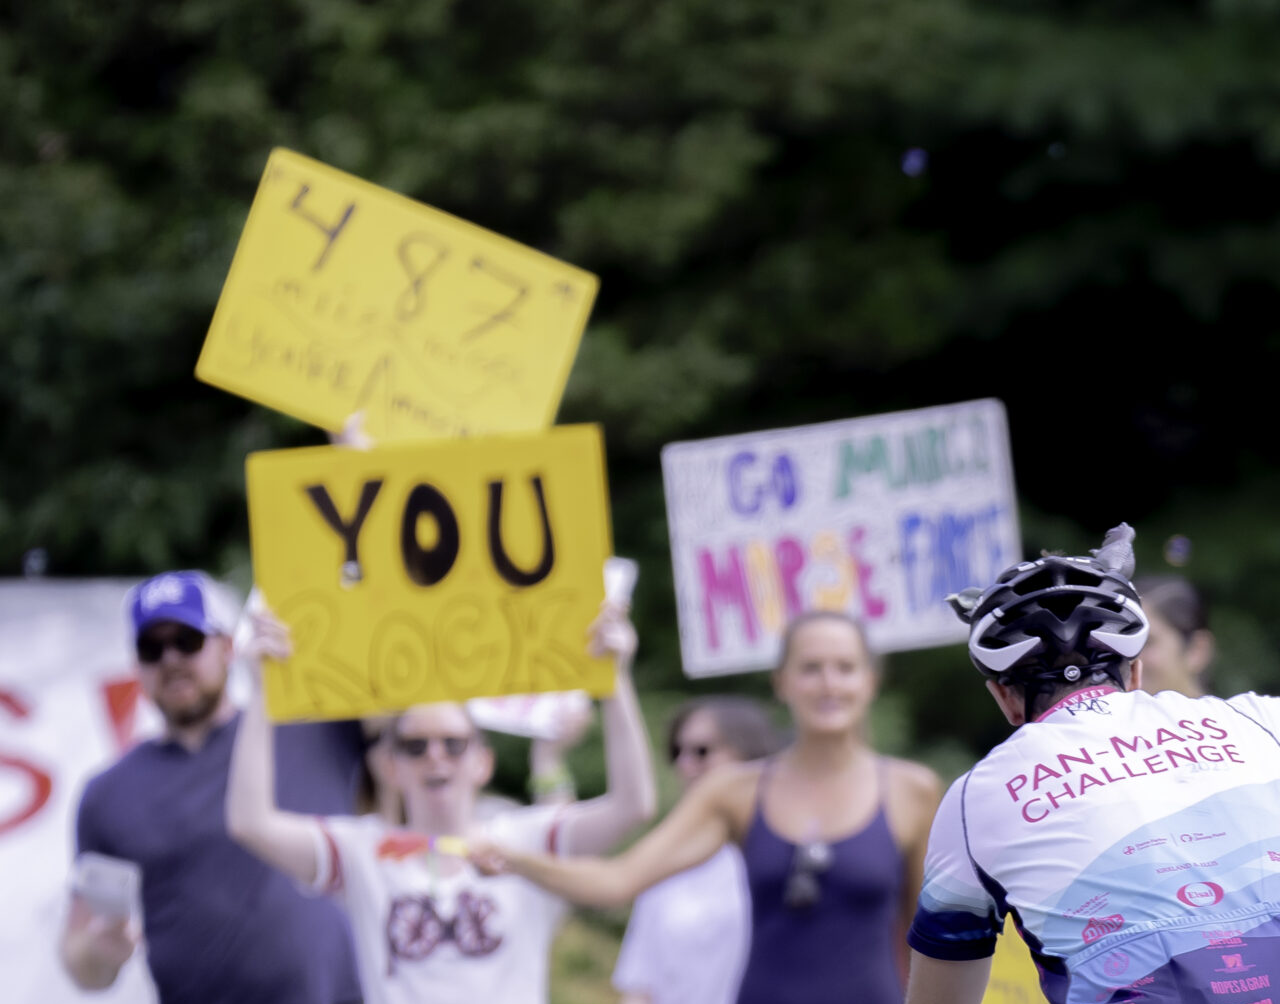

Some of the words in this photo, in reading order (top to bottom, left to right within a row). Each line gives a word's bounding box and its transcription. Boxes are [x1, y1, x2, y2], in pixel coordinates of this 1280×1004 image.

[302, 473, 555, 588] YOU
[1005, 717, 1229, 803] PAN-MASS
[1021, 743, 1246, 823] CHALLENGE
